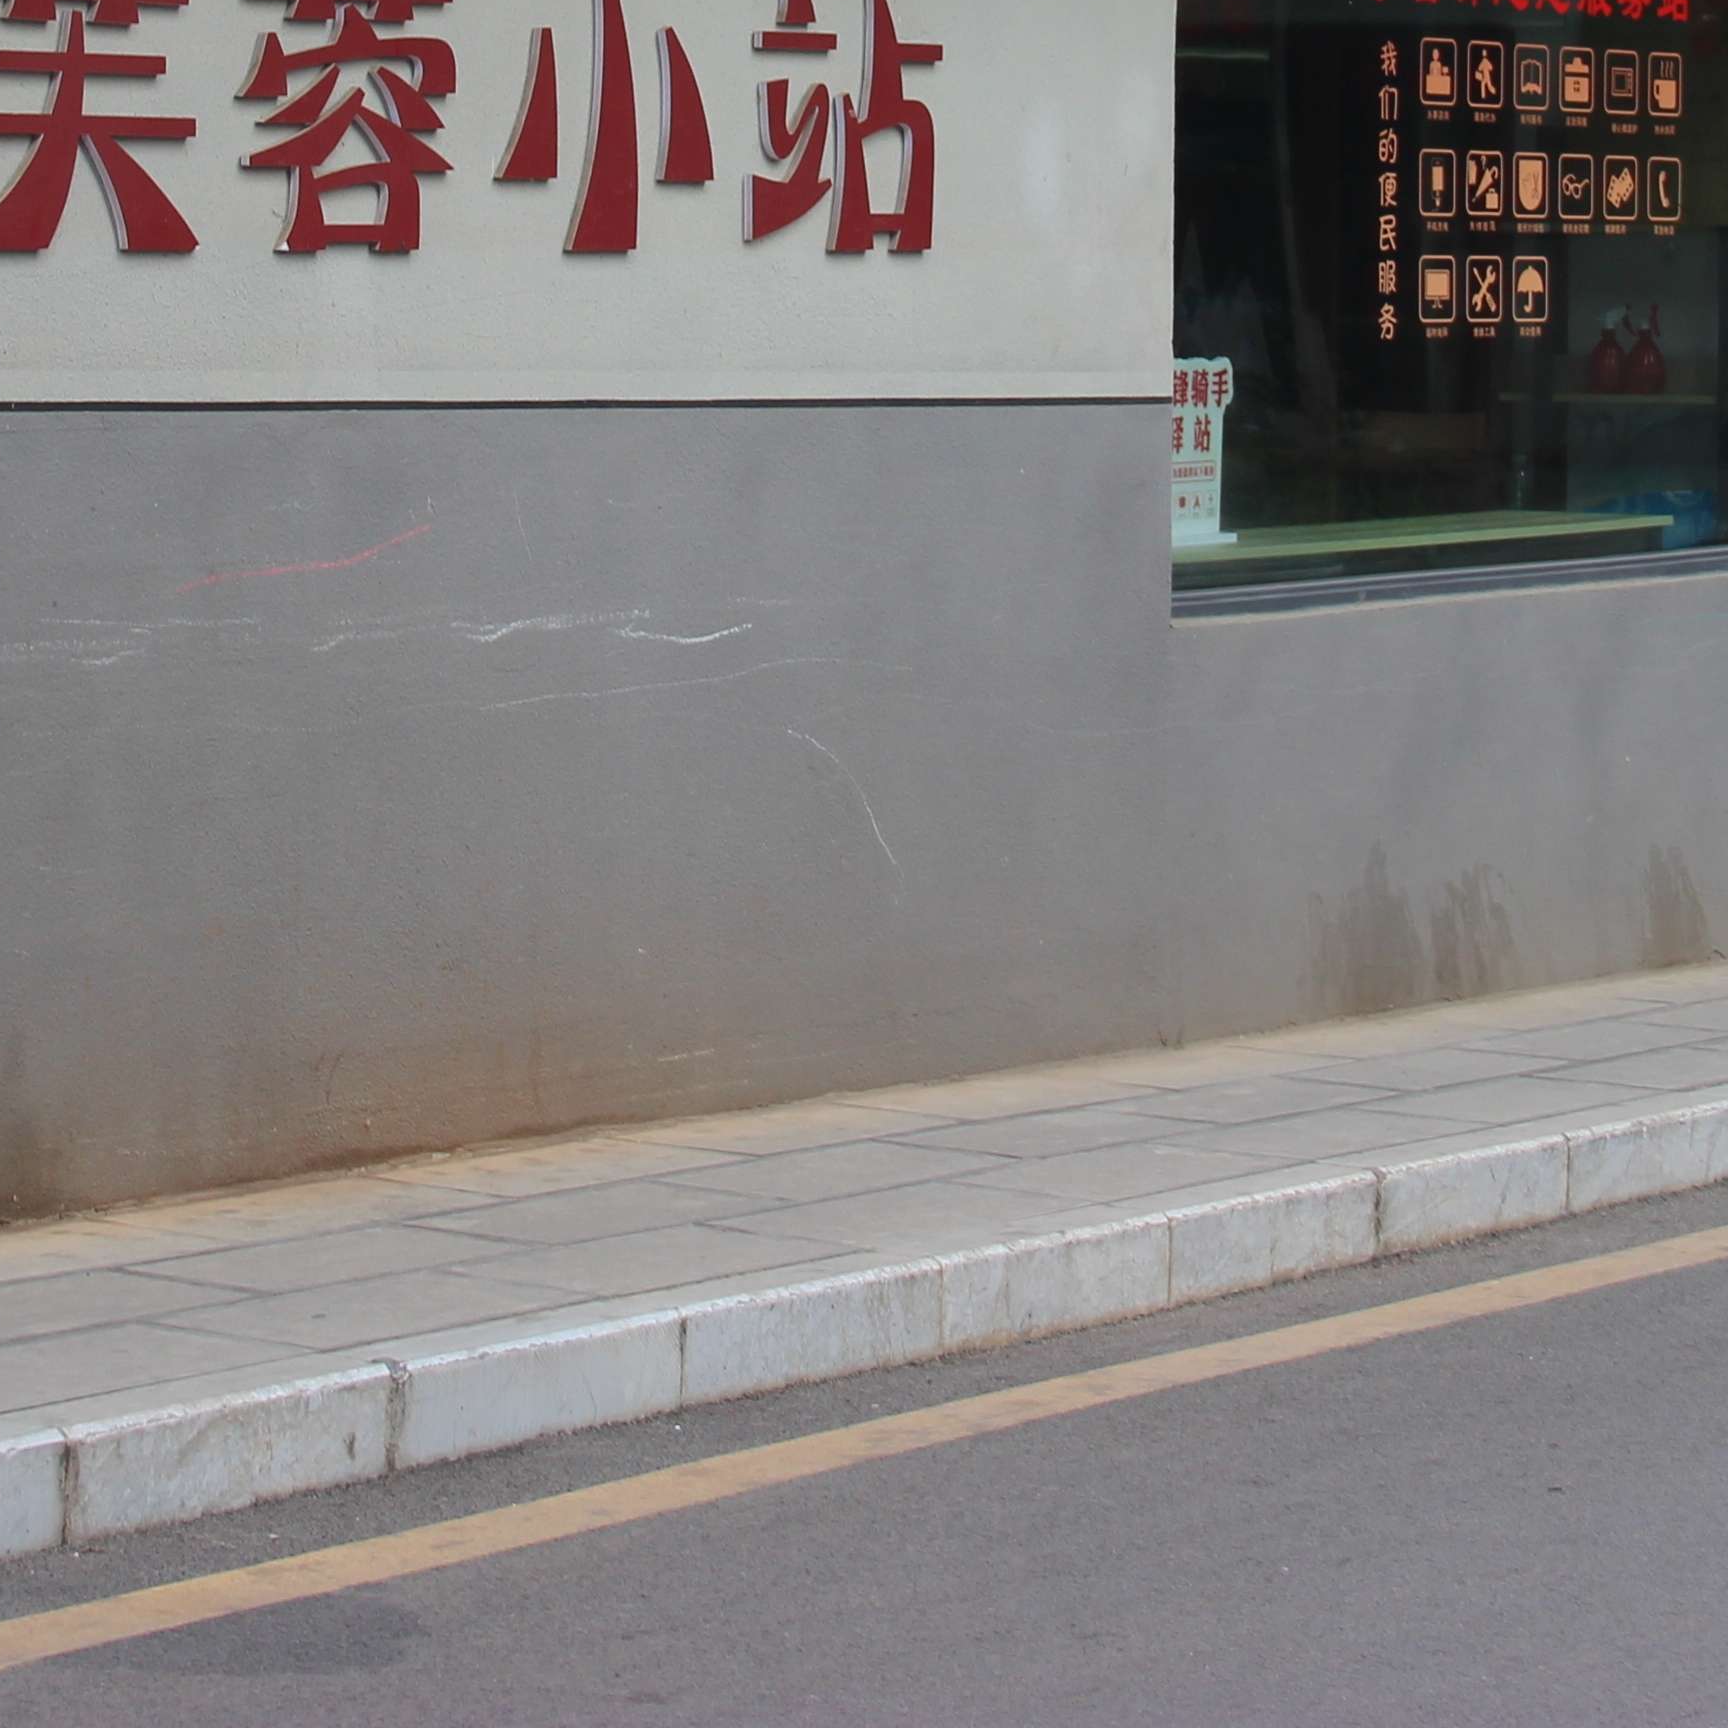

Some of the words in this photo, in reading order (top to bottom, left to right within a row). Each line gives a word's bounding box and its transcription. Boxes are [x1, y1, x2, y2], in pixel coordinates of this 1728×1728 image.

[1377, 39, 1400, 341] 我们的便民服务
